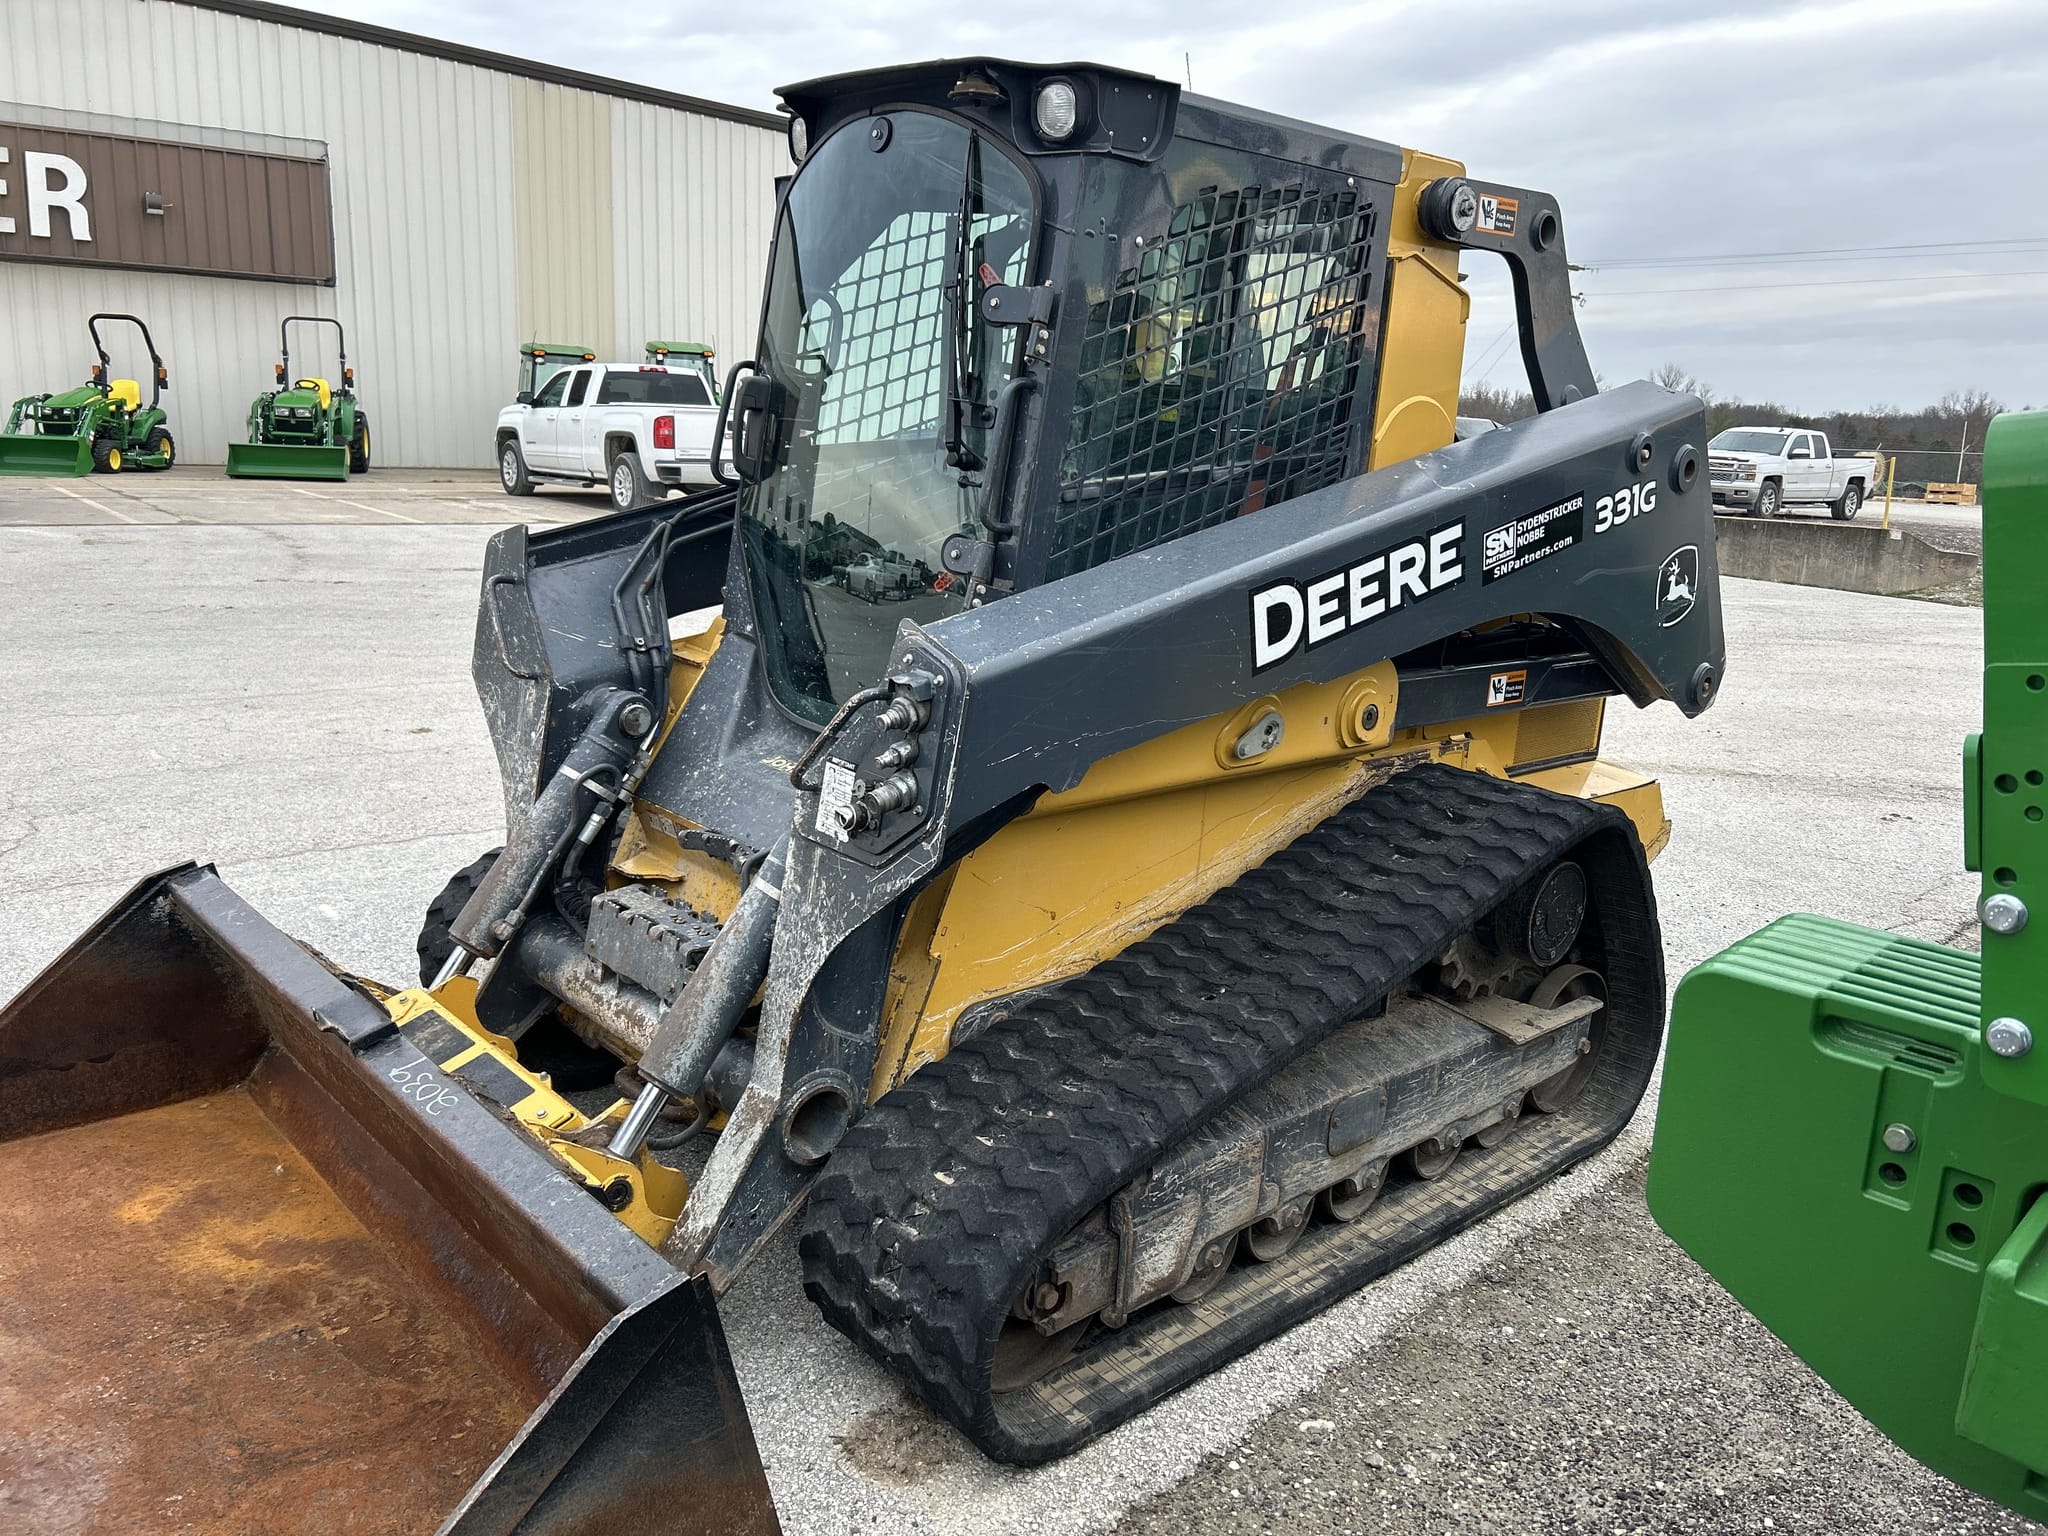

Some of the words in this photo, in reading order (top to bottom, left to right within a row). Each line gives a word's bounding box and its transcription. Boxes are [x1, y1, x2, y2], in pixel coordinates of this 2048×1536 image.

[1516, 496, 1583, 535] SYDENSTRICKER
[1594, 480, 1657, 533] 331G
[1486, 526, 1514, 557] SN
[1493, 535, 1573, 578] SNPartners.com
[1516, 525, 1546, 548] NOBBE
[1485, 549, 1514, 566] PARTNERS
[1253, 523, 1464, 669] DEERE
[389, 1057, 458, 1116] 2039
